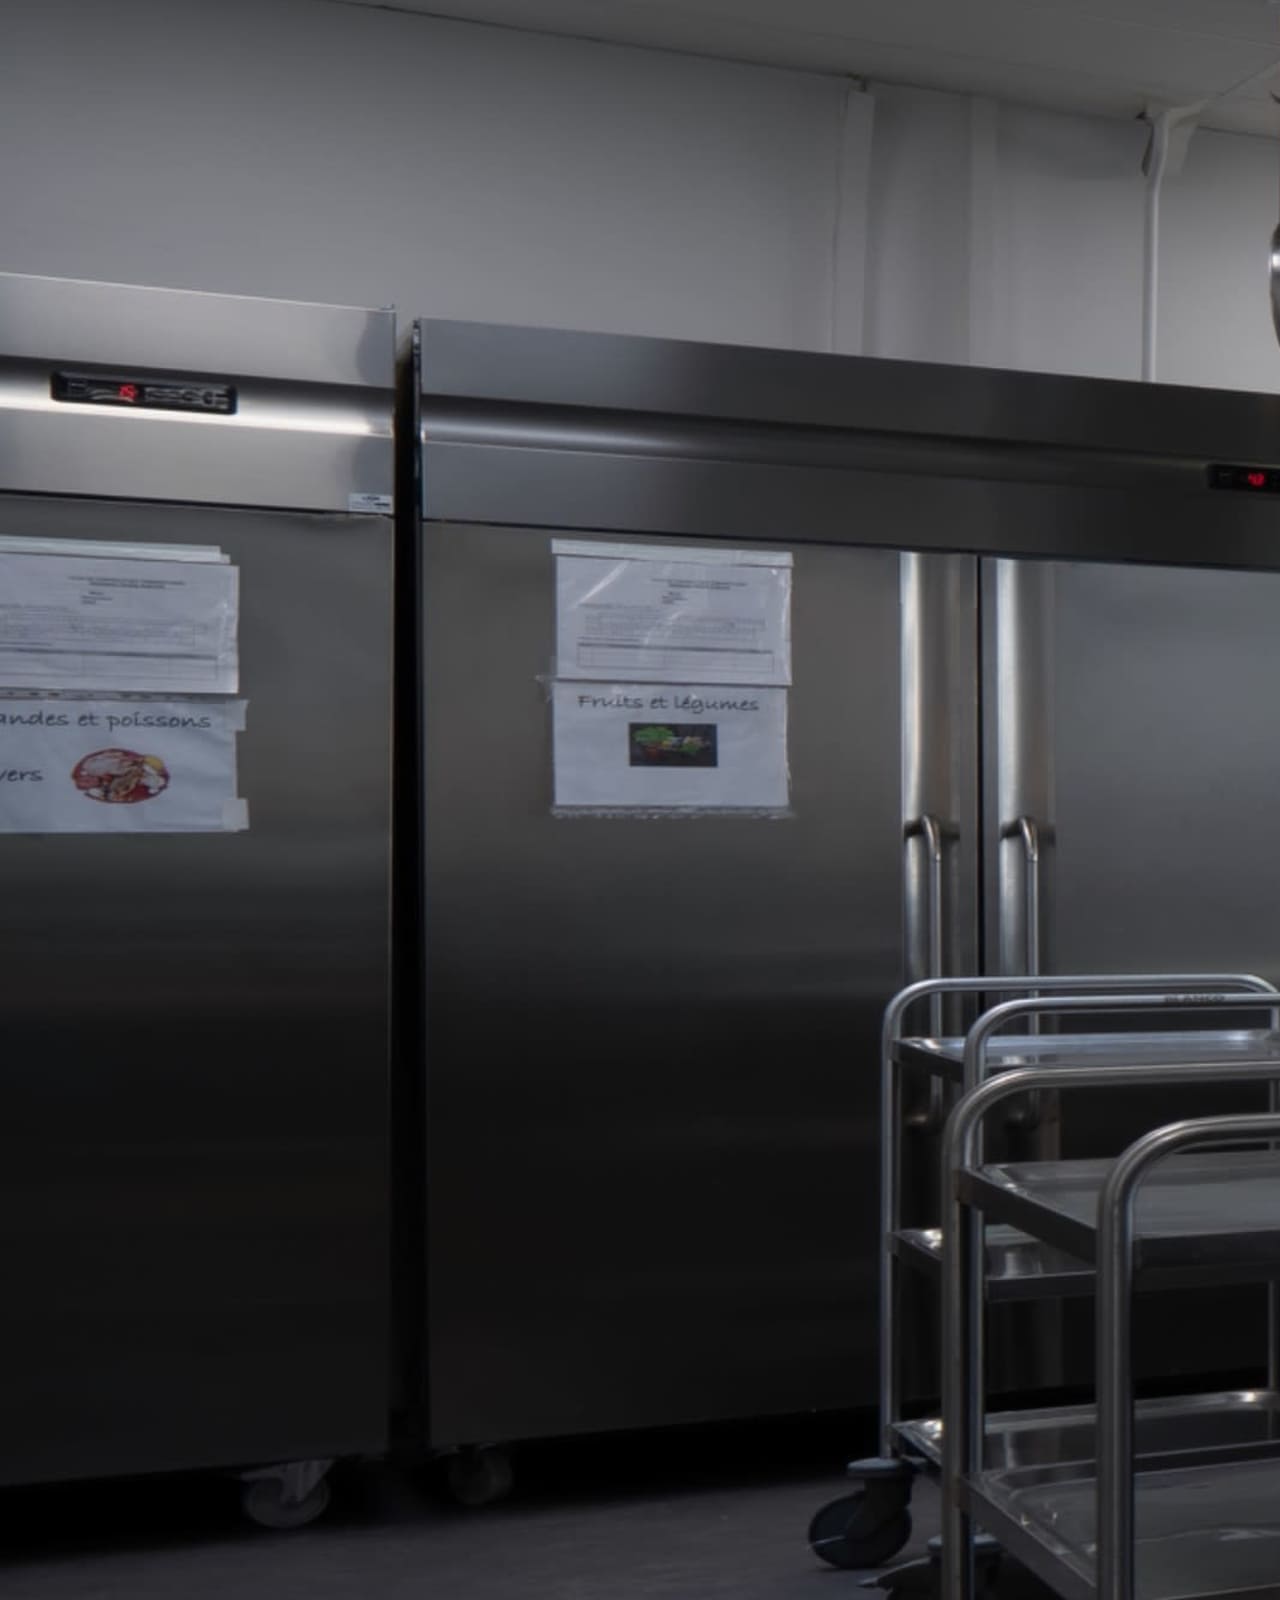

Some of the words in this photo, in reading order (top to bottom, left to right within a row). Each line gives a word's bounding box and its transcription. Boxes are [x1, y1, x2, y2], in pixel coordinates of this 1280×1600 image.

[577, 695, 643, 709] Fruits
[650, 698, 668, 709] et
[675, 696, 760, 714] légumes
[77, 714, 97, 726] et
[107, 711, 211, 731] poissons
